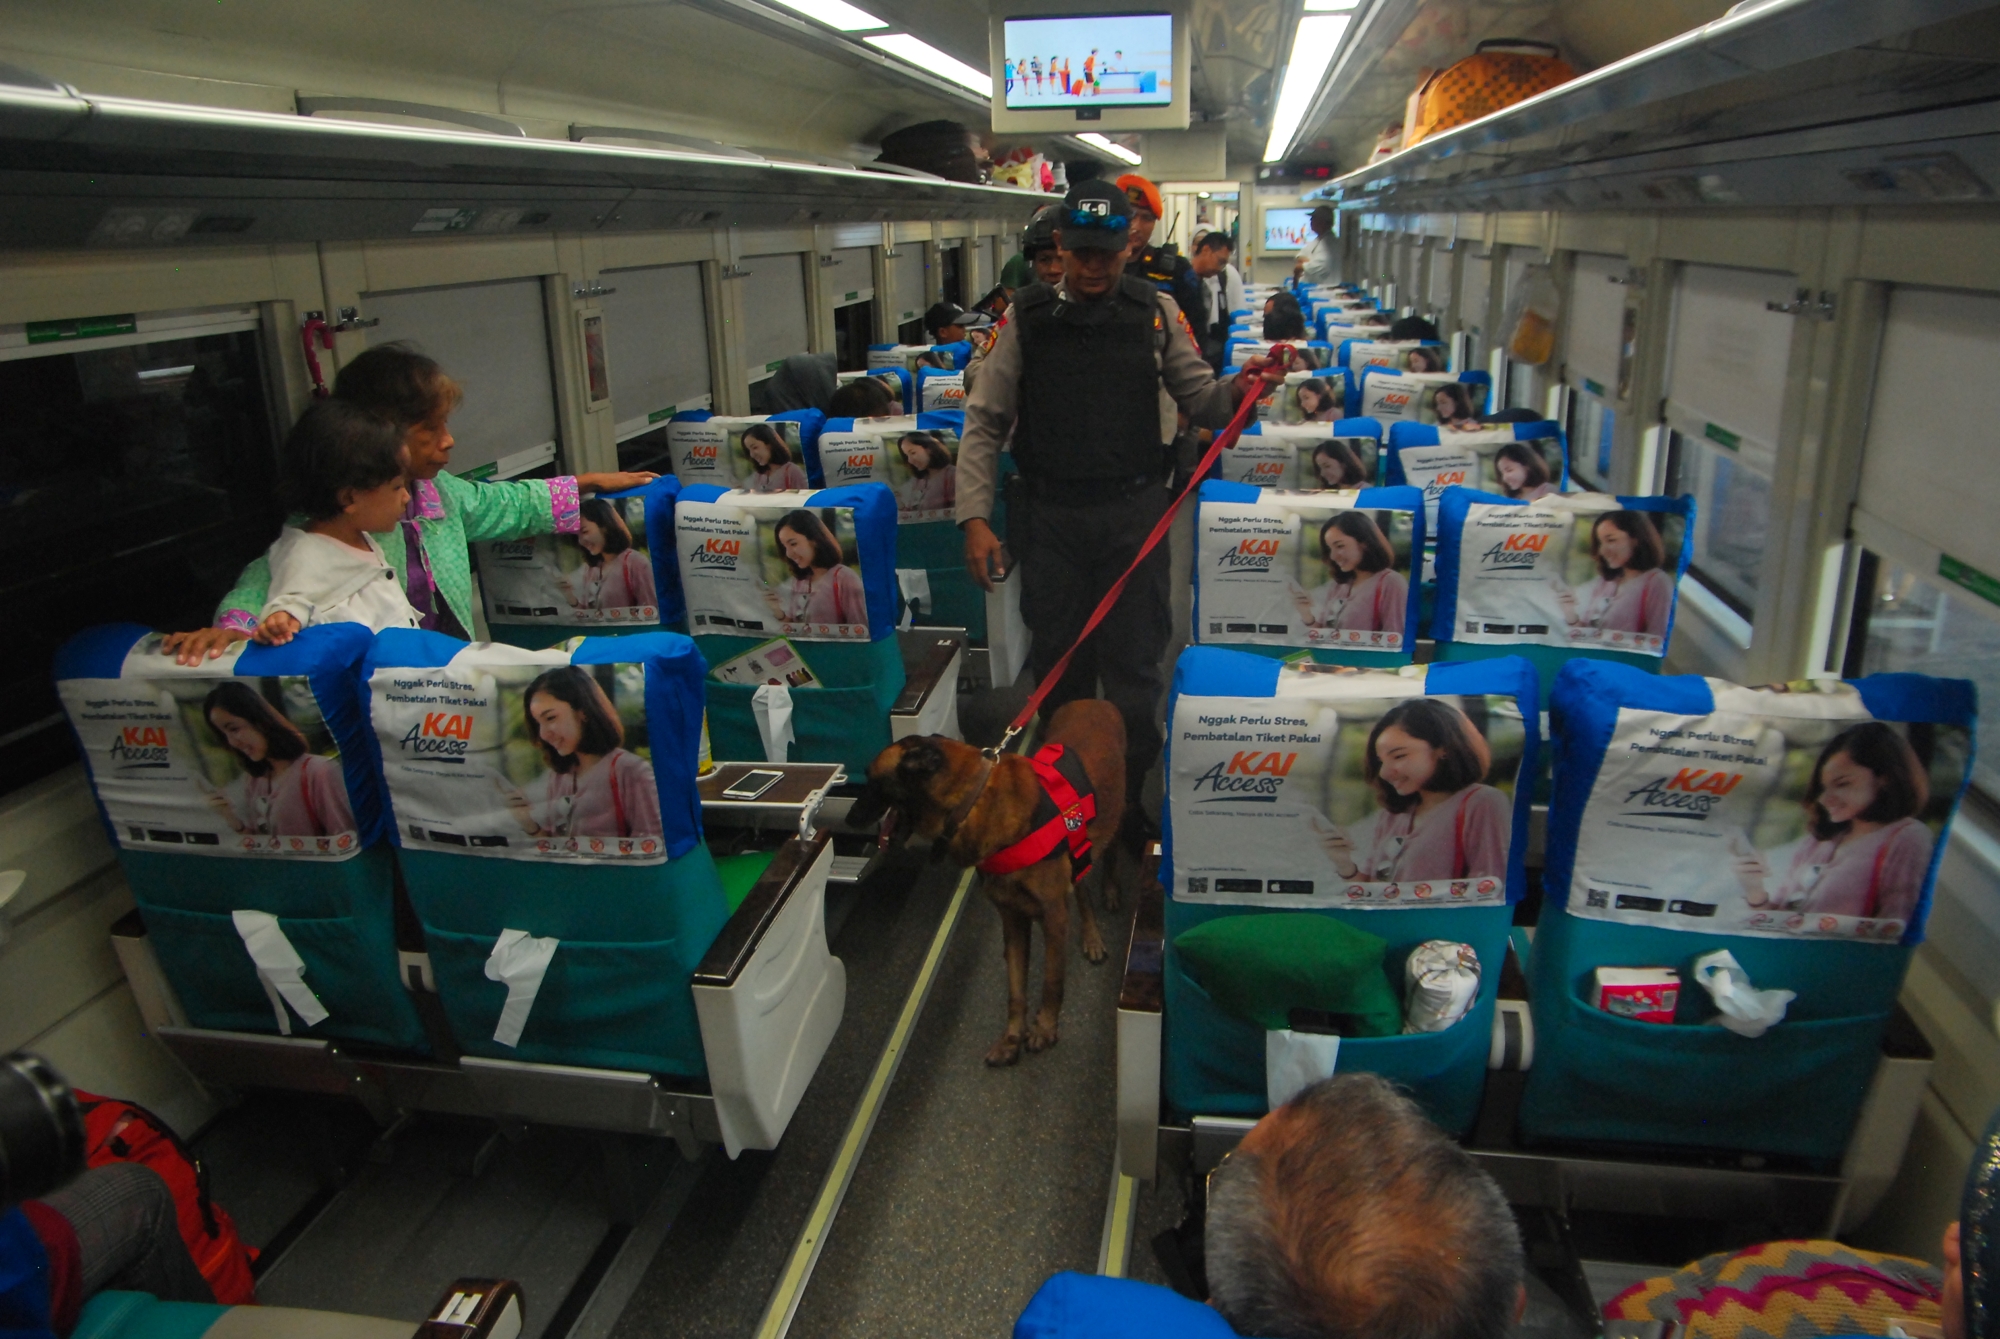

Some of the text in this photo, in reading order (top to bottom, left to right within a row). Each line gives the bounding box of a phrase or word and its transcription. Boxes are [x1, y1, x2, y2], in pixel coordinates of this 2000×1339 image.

[1082, 202, 1107, 216] K-9
[944, 389, 964, 398] KAI
[1385, 394, 1409, 405] KAI
[682, 451, 716, 465] Access
[693, 446, 717, 457] KAI
[837, 461, 872, 477] Access
[848, 455, 874, 467] KAI
[1255, 463, 1284, 474] KAI
[1240, 468, 1280, 483] Access
[1436, 471, 1466, 485] KAI
[706, 538, 741, 555] KAI
[1239, 539, 1279, 556] KAI
[1504, 534, 1549, 552] KAI
[690, 545, 737, 565] Access
[1218, 546, 1273, 567] Access
[1482, 542, 1540, 563] Access
[394, 679, 474, 691] Nggak Perlu Stres,
[386, 694, 487, 707] Pembatalan Tiket Pakai
[422, 712, 473, 740] KAI
[1198, 715, 1308, 727] Nggak Perlu Stres,
[123, 727, 167, 746] KAI
[400, 723, 468, 755] Access
[1184, 732, 1321, 743] Pembatalan Tiket Pakai
[1688, 731, 1719, 742] Perlu
[1723, 734, 1756, 748] Stres,
[110, 735, 168, 761] Access
[1630, 743, 1767, 765] Pembatalan Tiket Pakai
[1227, 751, 1297, 776] KAI
[1193, 762, 1283, 794] Access
[1666, 768, 1743, 795] KAI
[1624, 777, 1721, 812] Access
